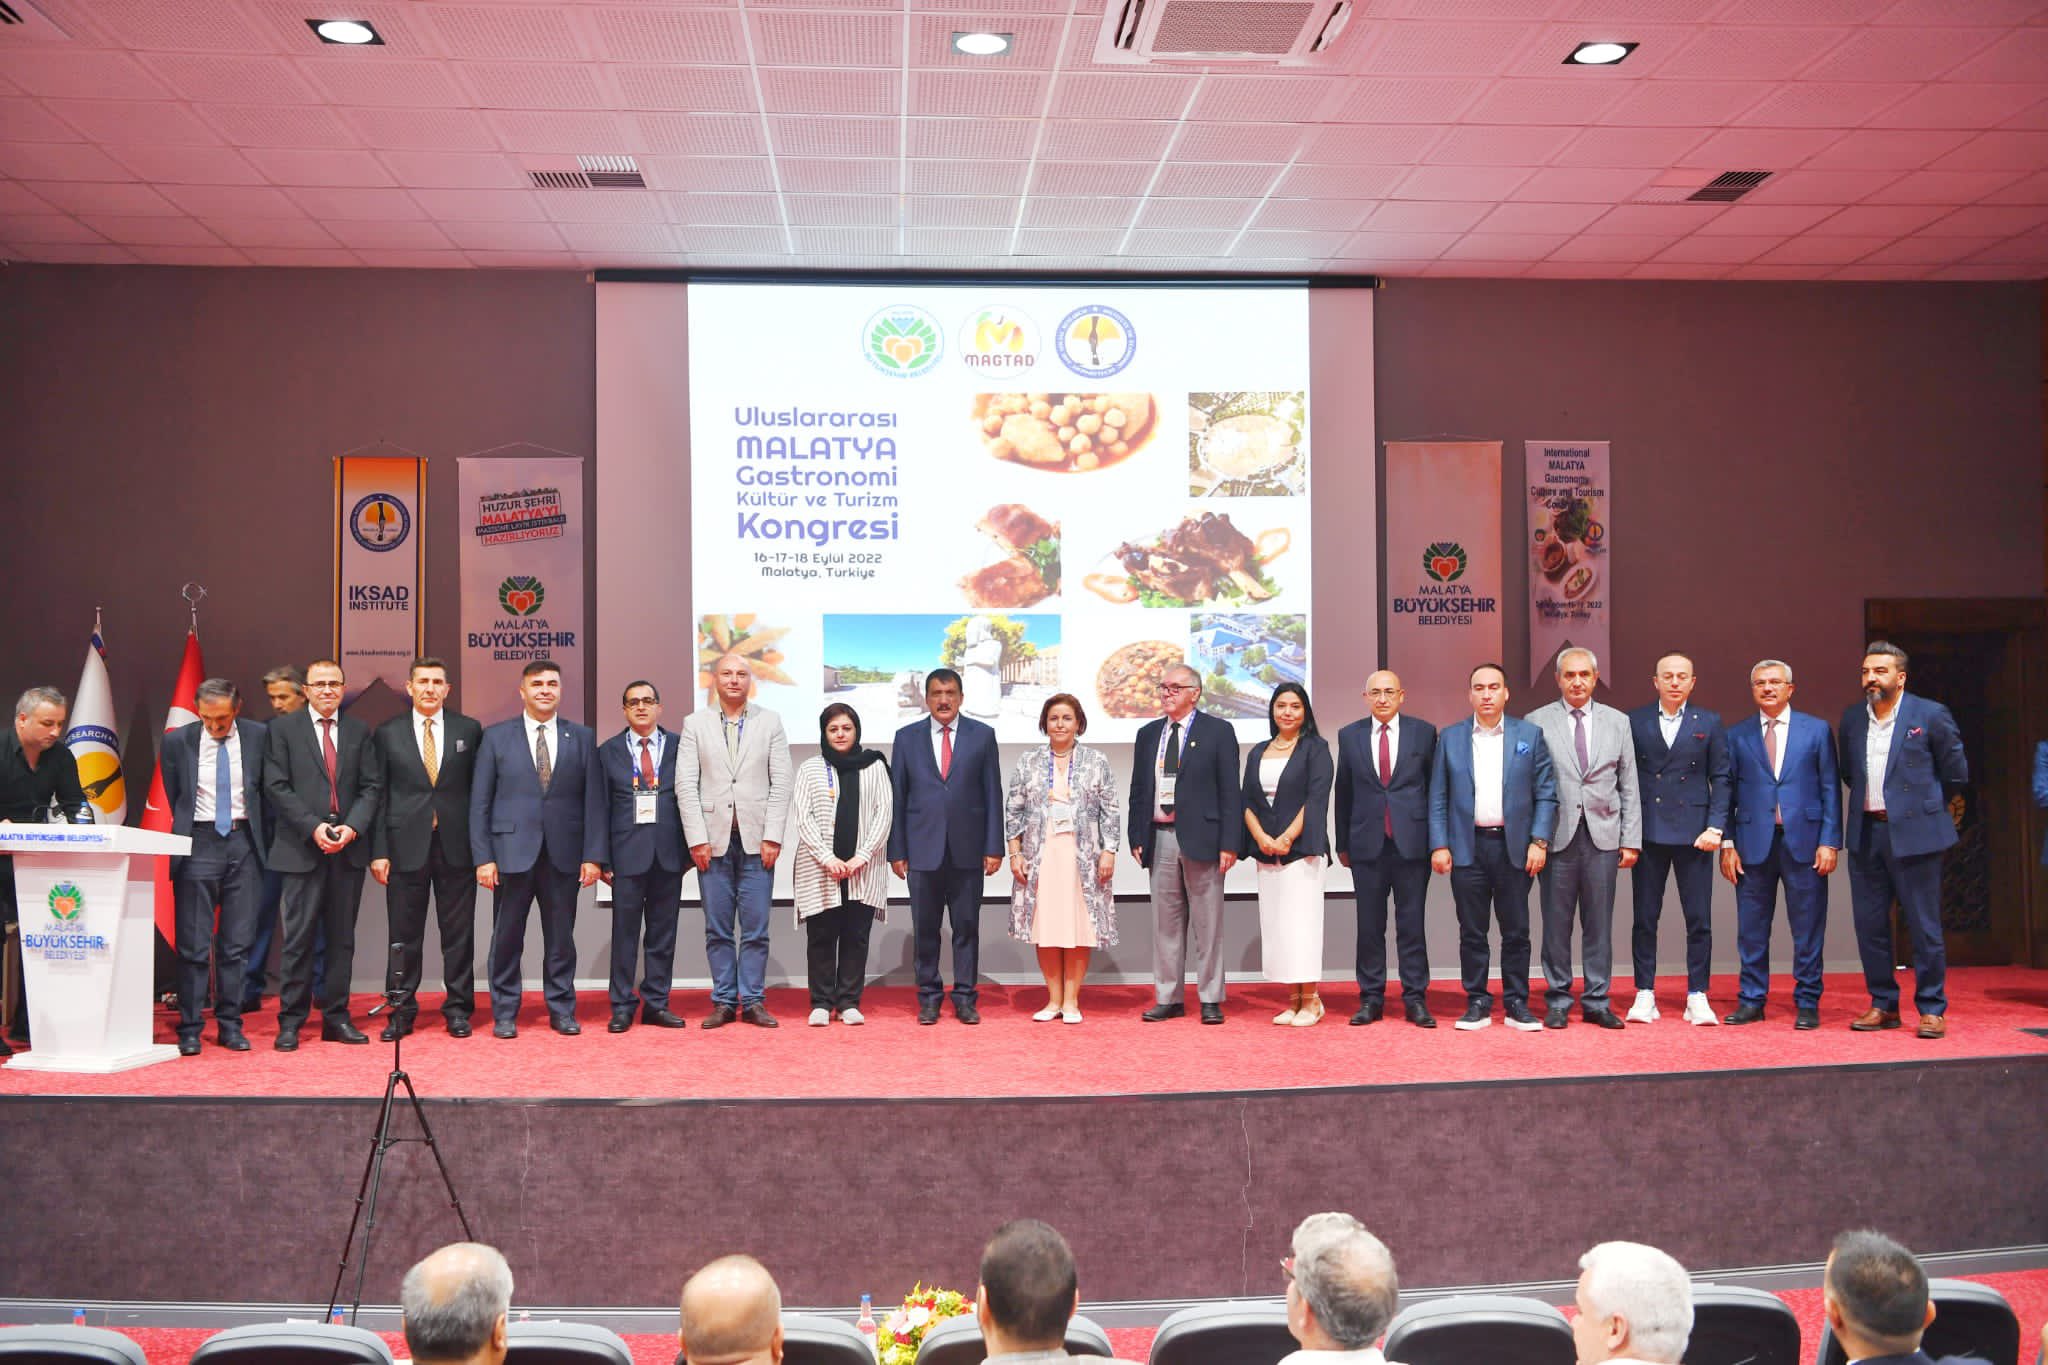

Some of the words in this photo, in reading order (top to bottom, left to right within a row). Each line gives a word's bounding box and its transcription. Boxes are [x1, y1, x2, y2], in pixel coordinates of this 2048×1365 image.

[964, 354, 1035, 367] MAGTAD
[735, 406, 897, 428] Uluslararası
[736, 436, 897, 460] MALATYA
[1544, 448, 1590, 458] International
[1548, 461, 1585, 470] MALATYA
[736, 465, 898, 486] Gastronomi
[737, 491, 798, 507] Kültür
[805, 495, 827, 507] ve
[833, 491, 898, 507] Turizm
[1575, 487, 1604, 497] Tourism
[482, 500, 522, 513] HUZUR
[482, 504, 560, 525] MALATYA'YI
[737, 512, 899, 547] Kongresi
[754, 552, 808, 563] 16-17-18
[813, 553, 844, 566] Eylül
[849, 553, 882, 564] 2022
[349, 585, 409, 601] IKSAD
[1419, 585, 1472, 595] MALATYA
[349, 601, 409, 611] INSTITUTE
[1393, 598, 1496, 613] BÜYÜKŞEHİR
[494, 619, 550, 630] MALATYA
[468, 632, 576, 649] BÜYÜKŞEHİR
[494, 650, 551, 660] BELEDİYESİ
[65, 730, 107, 744] ESEARCH
[0, 833, 24, 841] ALATYA
